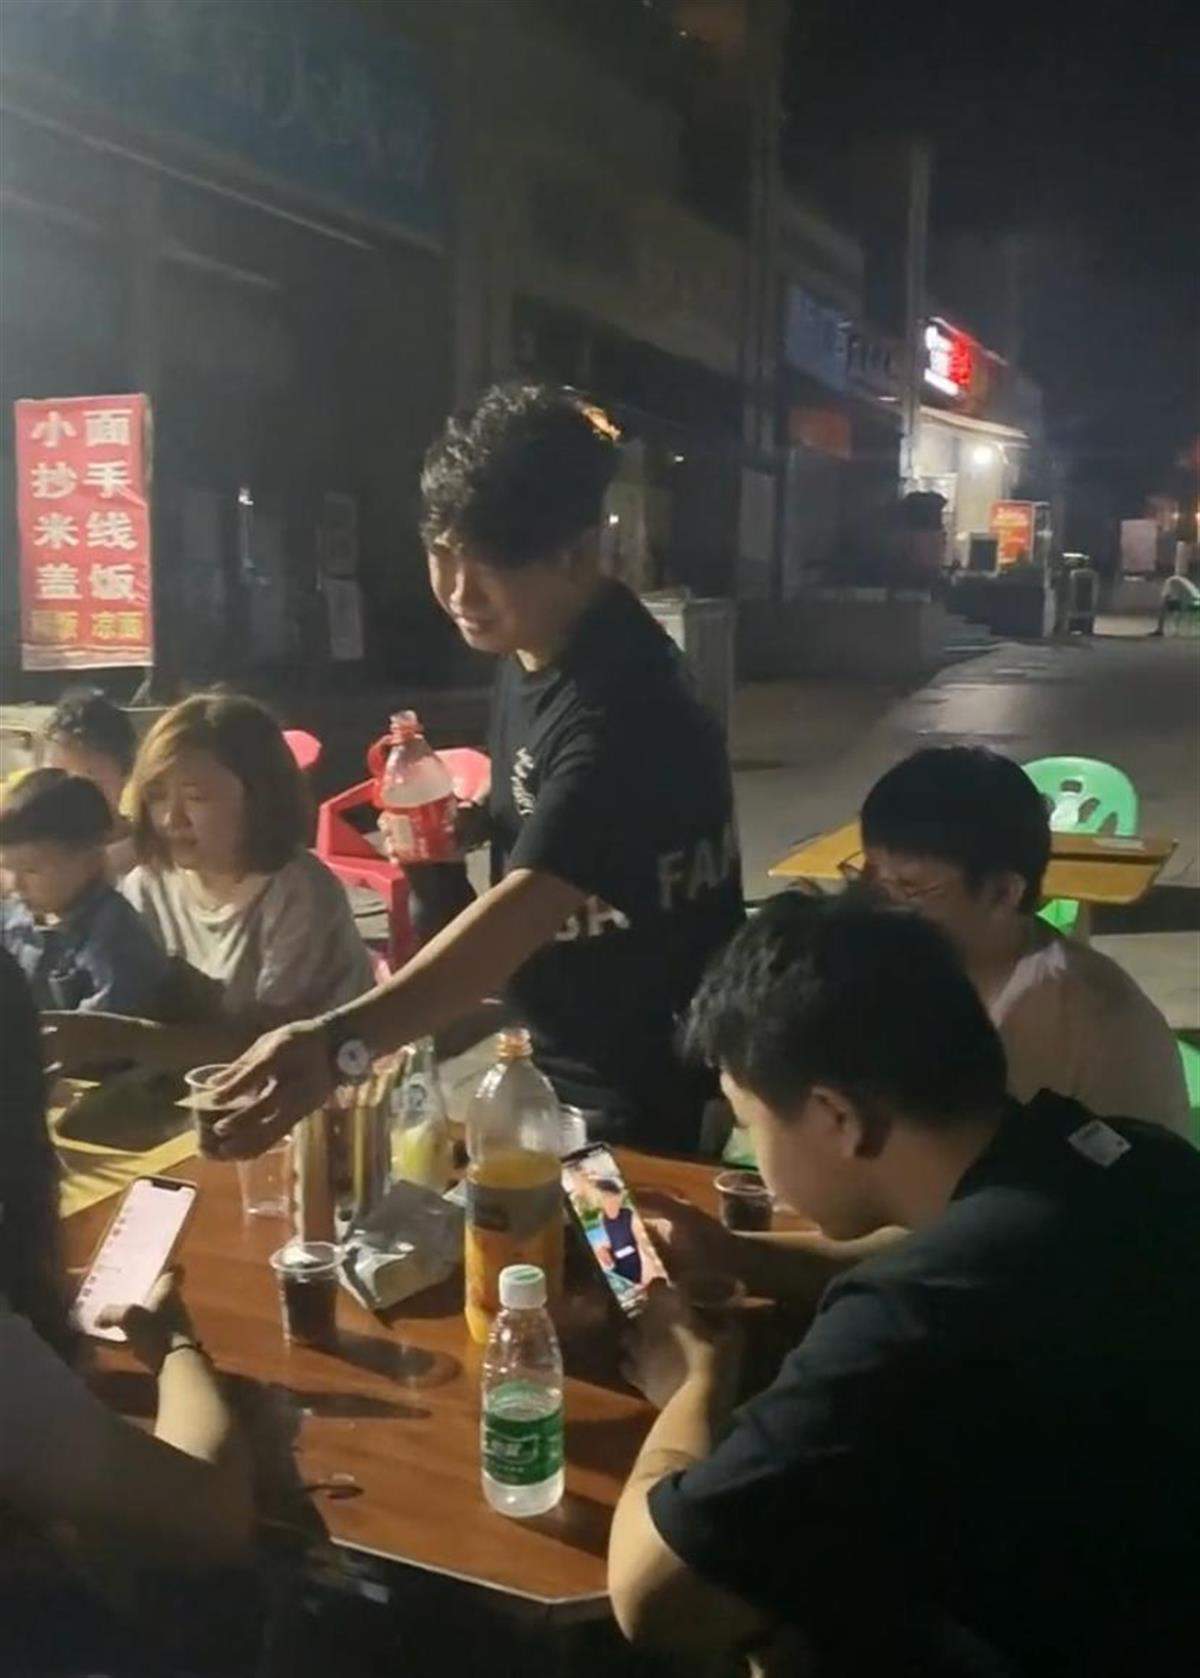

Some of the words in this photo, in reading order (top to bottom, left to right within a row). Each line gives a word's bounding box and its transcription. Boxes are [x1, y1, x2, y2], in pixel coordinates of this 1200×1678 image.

[30, 409, 133, 448] 小面
[31, 461, 132, 499] 抄手
[33, 511, 137, 550] 米线
[36, 563, 135, 600] 盖饭
